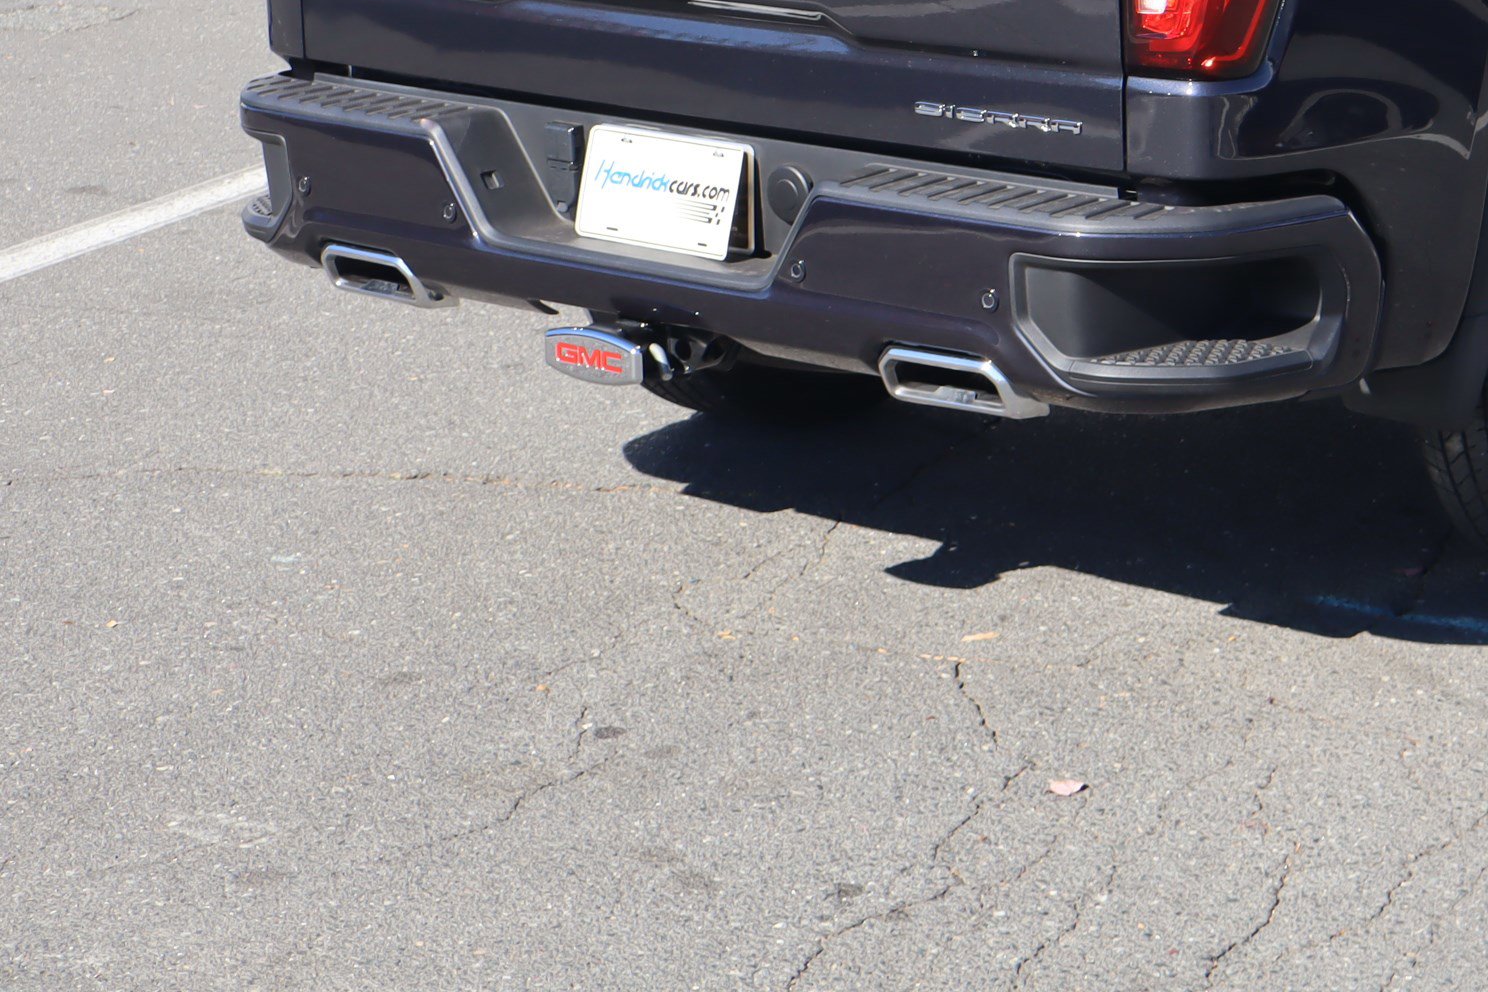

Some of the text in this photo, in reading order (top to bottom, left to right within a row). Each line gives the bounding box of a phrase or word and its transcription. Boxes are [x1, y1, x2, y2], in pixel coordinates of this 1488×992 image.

[914, 101, 1083, 135] SIERRA
[594, 159, 730, 201] Hendrickcars.com
[554, 341, 623, 374] GMC
